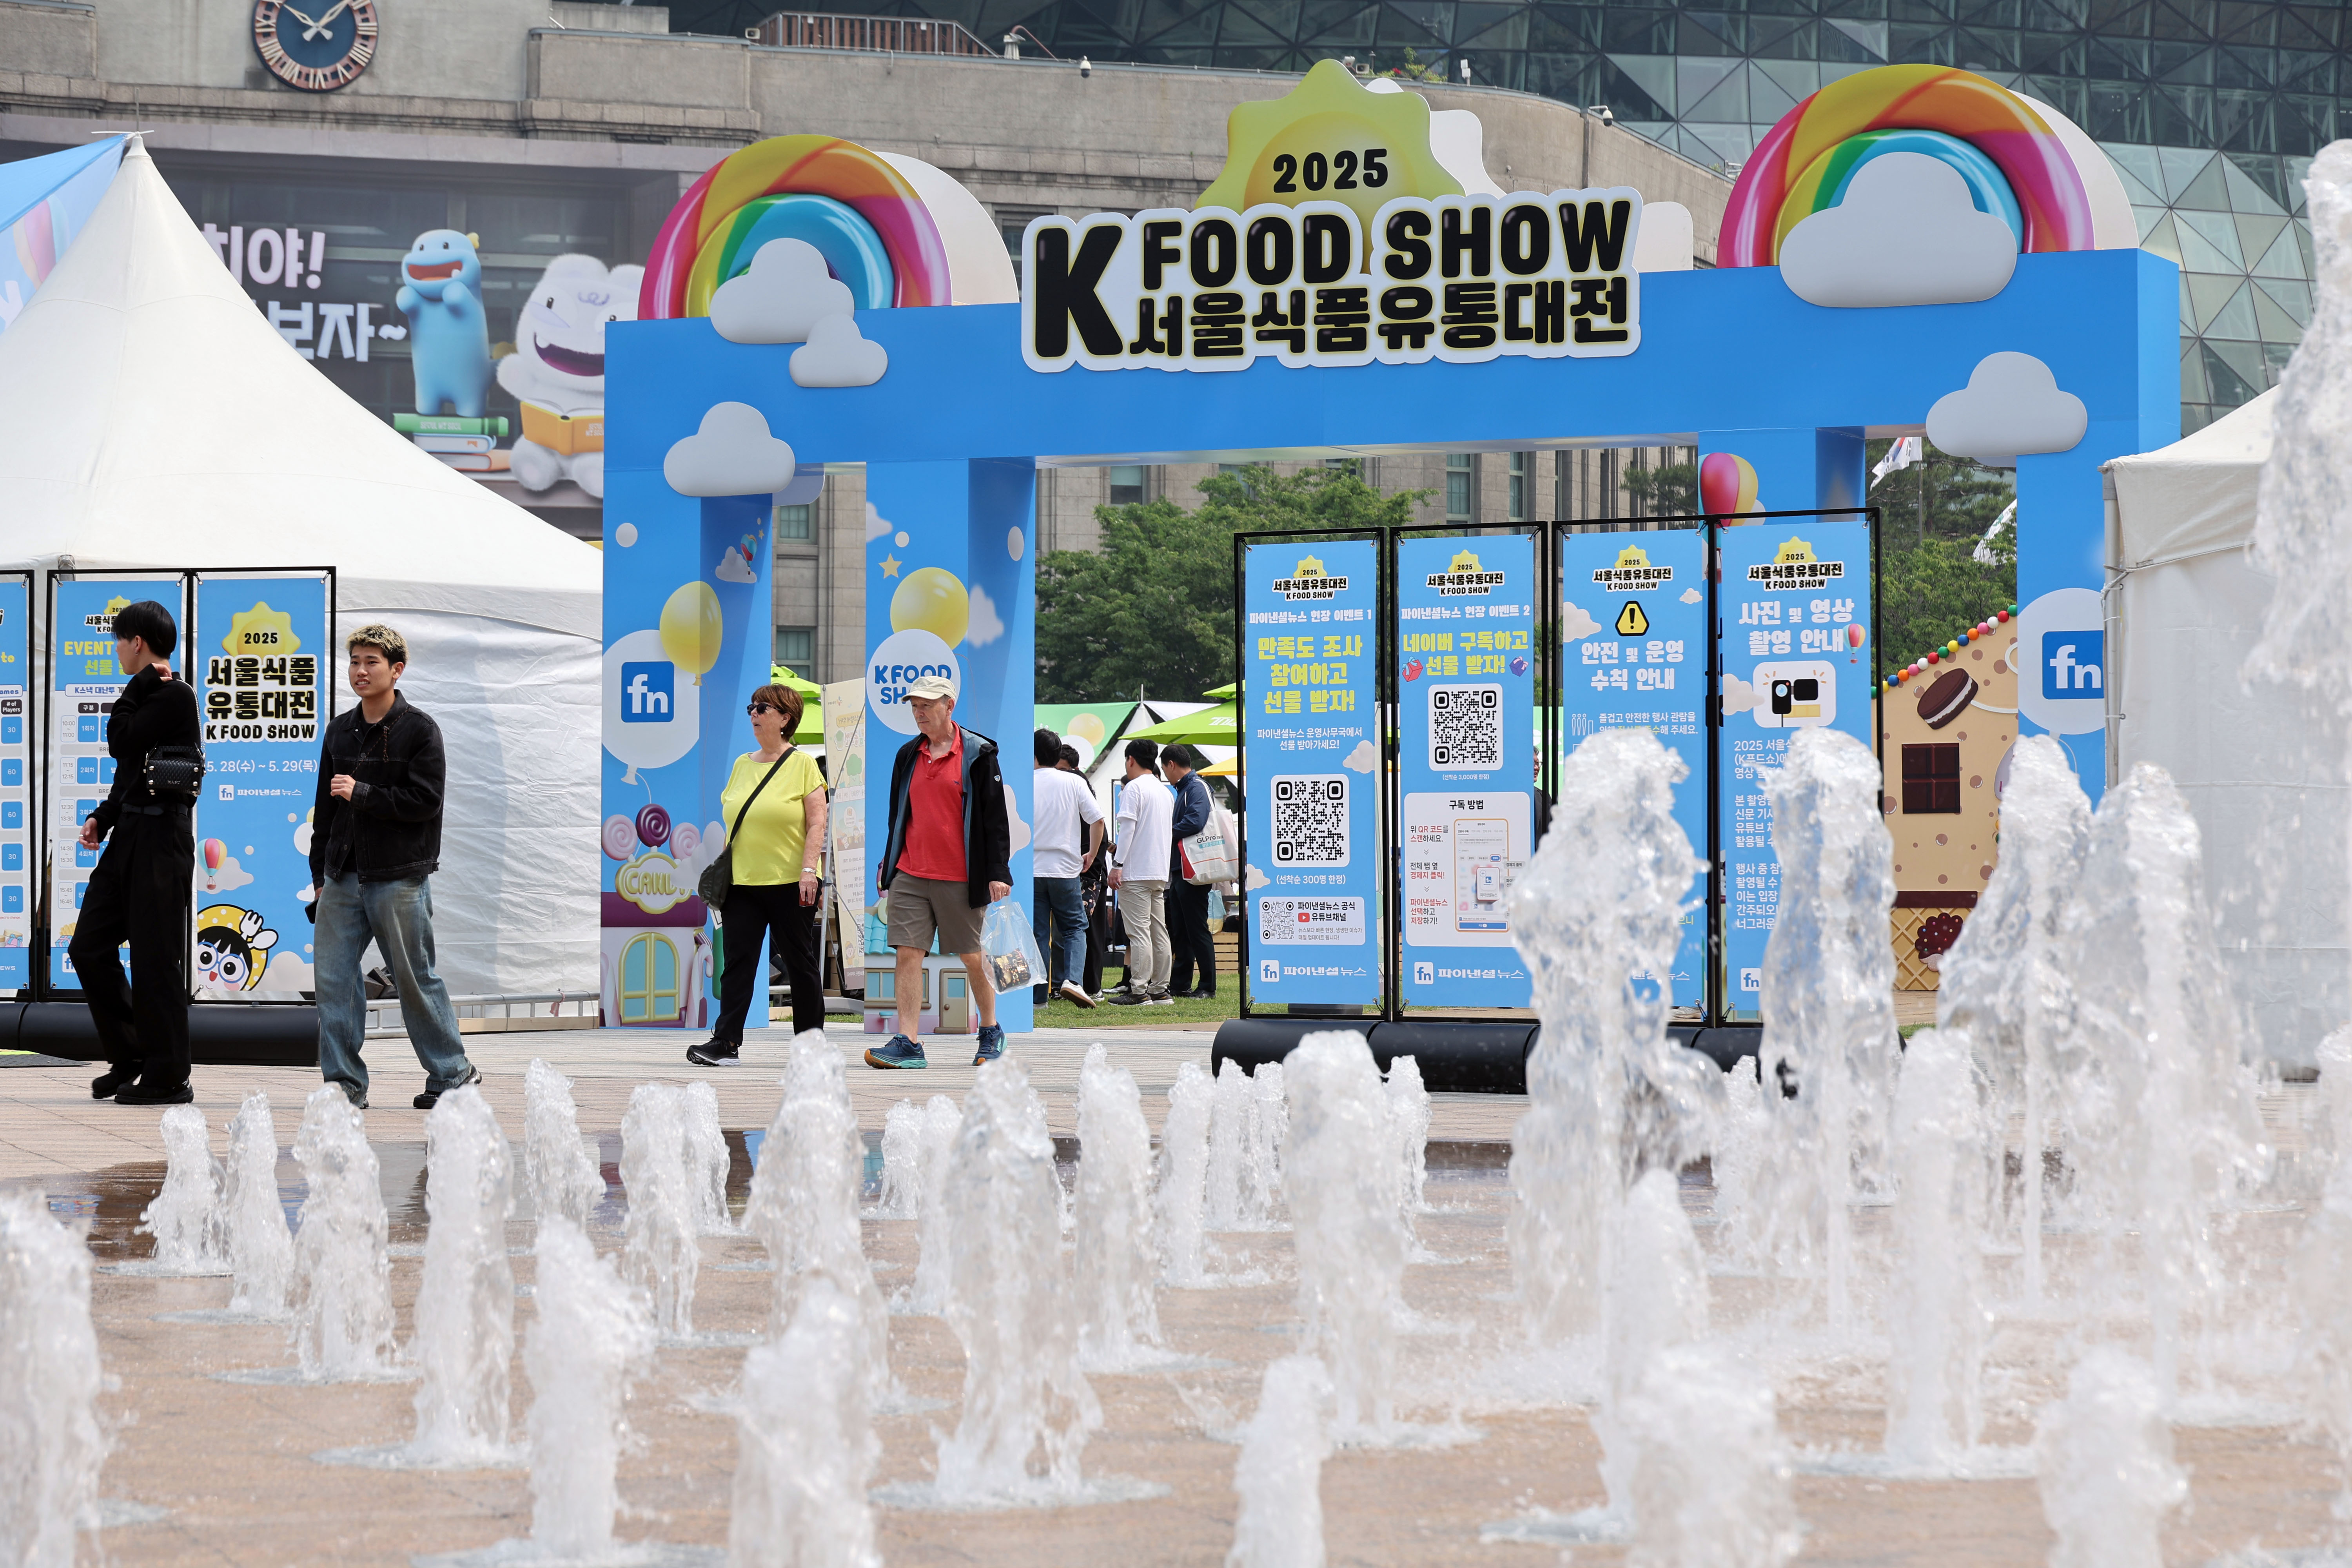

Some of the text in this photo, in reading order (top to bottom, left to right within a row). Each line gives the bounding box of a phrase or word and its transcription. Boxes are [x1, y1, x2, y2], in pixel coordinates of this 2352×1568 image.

[1273, 148, 1389, 193] 2025
[1034, 200, 1631, 359] K FOOD SHOW
[1129, 276, 1628, 355] 서울식품유통대전
[1593, 568, 1671, 582] 서울식품유통대전
[1749, 563, 1842, 579] 서울식품유통대전
[1273, 578, 1347, 592] 서울식품유통대전
[1427, 573, 1503, 586] 서울식품유통대전
[1766, 579, 1825, 590] K FOOD SHOW
[1249, 609, 1372, 624] 파이낸셜뉴스 현장 이벤트 1
[1401, 605, 1530, 619] 파이낸셜뉴스 현장 이벤트 2
[1739, 599, 1855, 625] 사진 및 영상
[245, 633, 278, 644] 2025
[1403, 631, 1528, 652] 네이버 구독하고
[1749, 629, 1844, 656] 촬영 안내
[64, 641, 114, 655] EVENT
[1258, 635, 1362, 660] 만족도 조사
[1582, 641, 1684, 664] 안전 및 운영
[85, 659, 113, 675] 선물
[208, 658, 314, 686] 서울식품
[1426, 655, 1505, 675] 선물 받자!
[2050, 645, 2101, 689] fn
[875, 665, 888, 684] K
[1271, 663, 1348, 686] 참여하고
[1591, 668, 1675, 691] 수칙 안내
[627, 674, 668, 713] fn
[208, 691, 314, 720] 유통대전
[1264, 690, 1355, 713] 선물 받자!
[1599, 711, 1696, 723] 즐겁고 안전한 행사 관람을
[207, 725, 315, 740] K FOOD SHOW
[1257, 727, 1362, 739] 파이낸셜뉴스 운영사무국에서
[1671, 725, 1698, 734] 주세요.
[1280, 739, 1339, 750] 선물 받아가세요!
[1734, 740, 1763, 751] 2025
[220, 760, 255, 773] 28(수)
[269, 761, 279, 772] 5.
[282, 759, 318, 773] 29(목)
[1735, 768, 1754, 779] 영상
[221, 788, 232, 798] fn
[1449, 800, 1484, 810] 구독 방법
[1735, 795, 1745, 806] 본
[1735, 808, 1755, 820] 신문
[1735, 822, 1764, 834] 유튜브
[1411, 835, 1443, 843] 스캔하세요.
[1735, 835, 1764, 848] 활용될
[1410, 871, 1428, 880] 경제지
[1735, 863, 1768, 875] 행사 중
[1276, 874, 1346, 885] (선착순 300명 한정)
[1736, 877, 1778, 888] 촬영될 수
[1737, 891, 1756, 902] 이는
[1298, 902, 1355, 911] 파이낸셜뉴스 공식
[1411, 916, 1438, 925] 저장하기!
[1263, 965, 1367, 979] fn 파이낸셜뉴스
[1417, 966, 1524, 981] fn 파이낸셜뉴스
